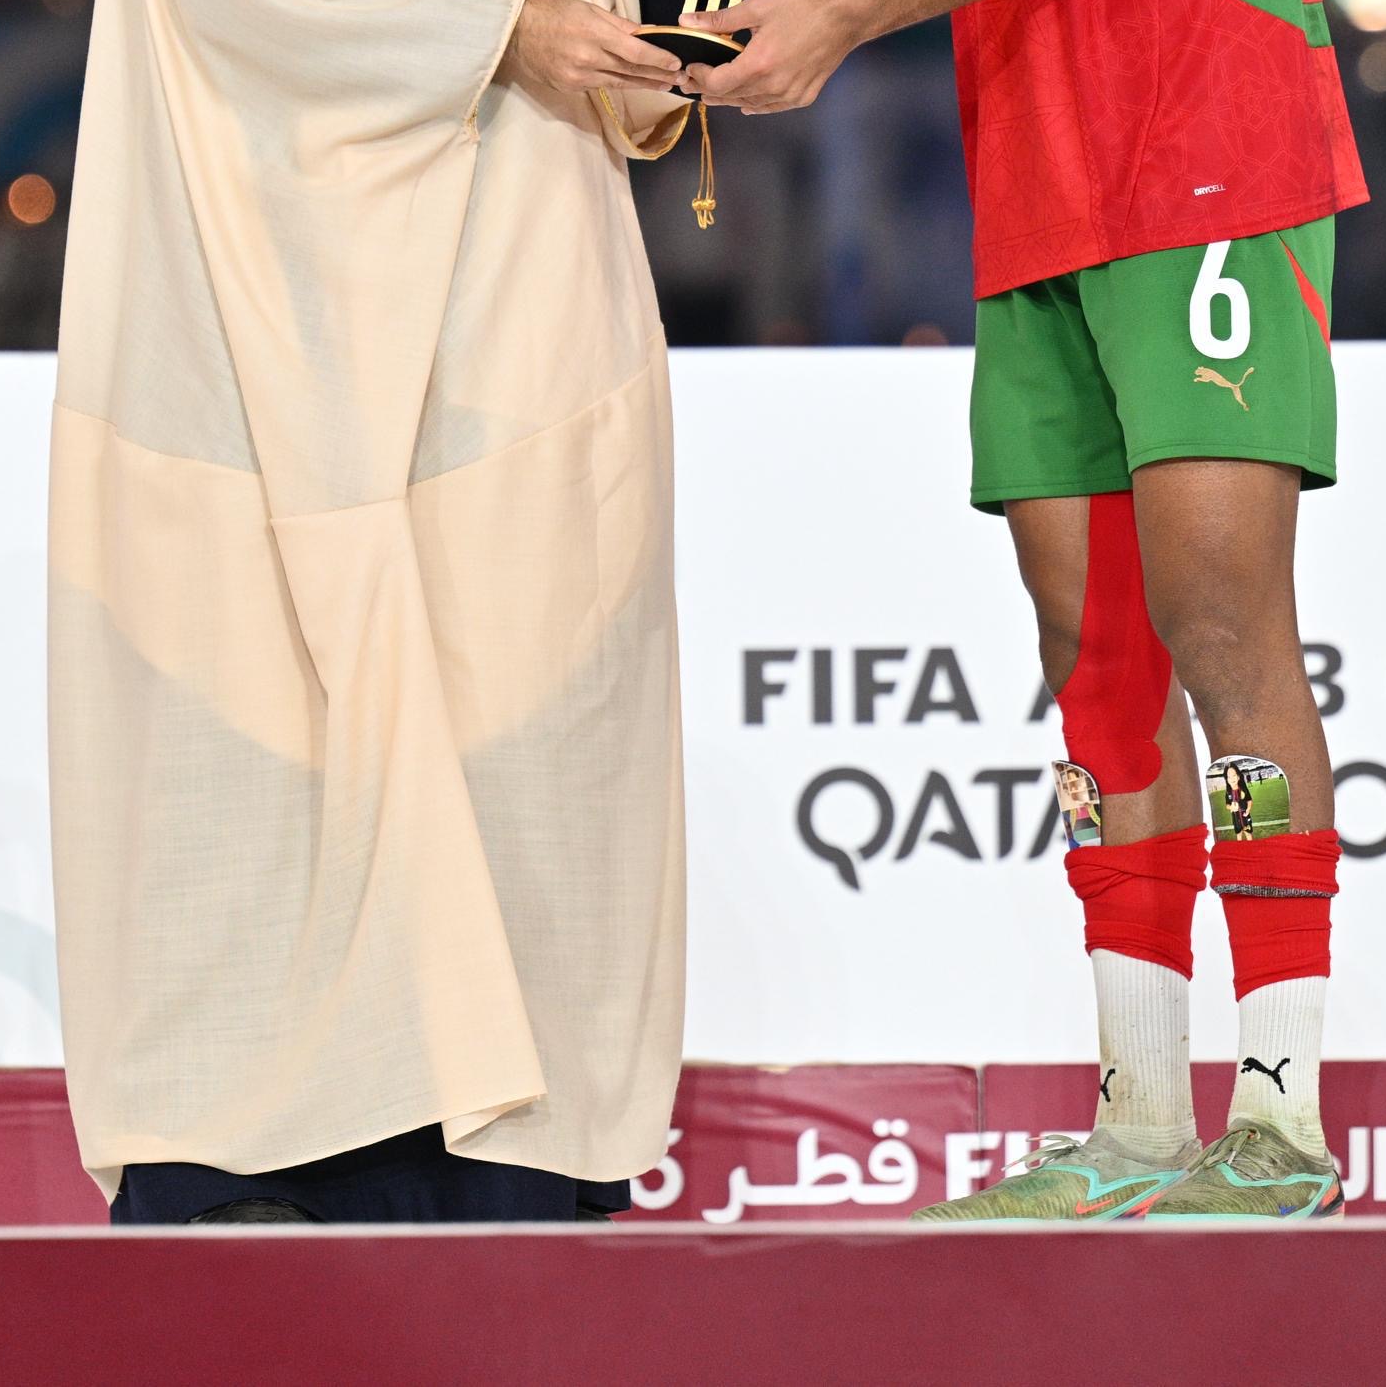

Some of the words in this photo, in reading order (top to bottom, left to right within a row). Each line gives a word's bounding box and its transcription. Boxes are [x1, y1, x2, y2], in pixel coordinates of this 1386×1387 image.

[1193, 184, 1226, 196] DRYCELL
[1189, 239, 1251, 360] 6
[741, 646, 982, 725] FIFA
[796, 767, 1063, 892] QAT
